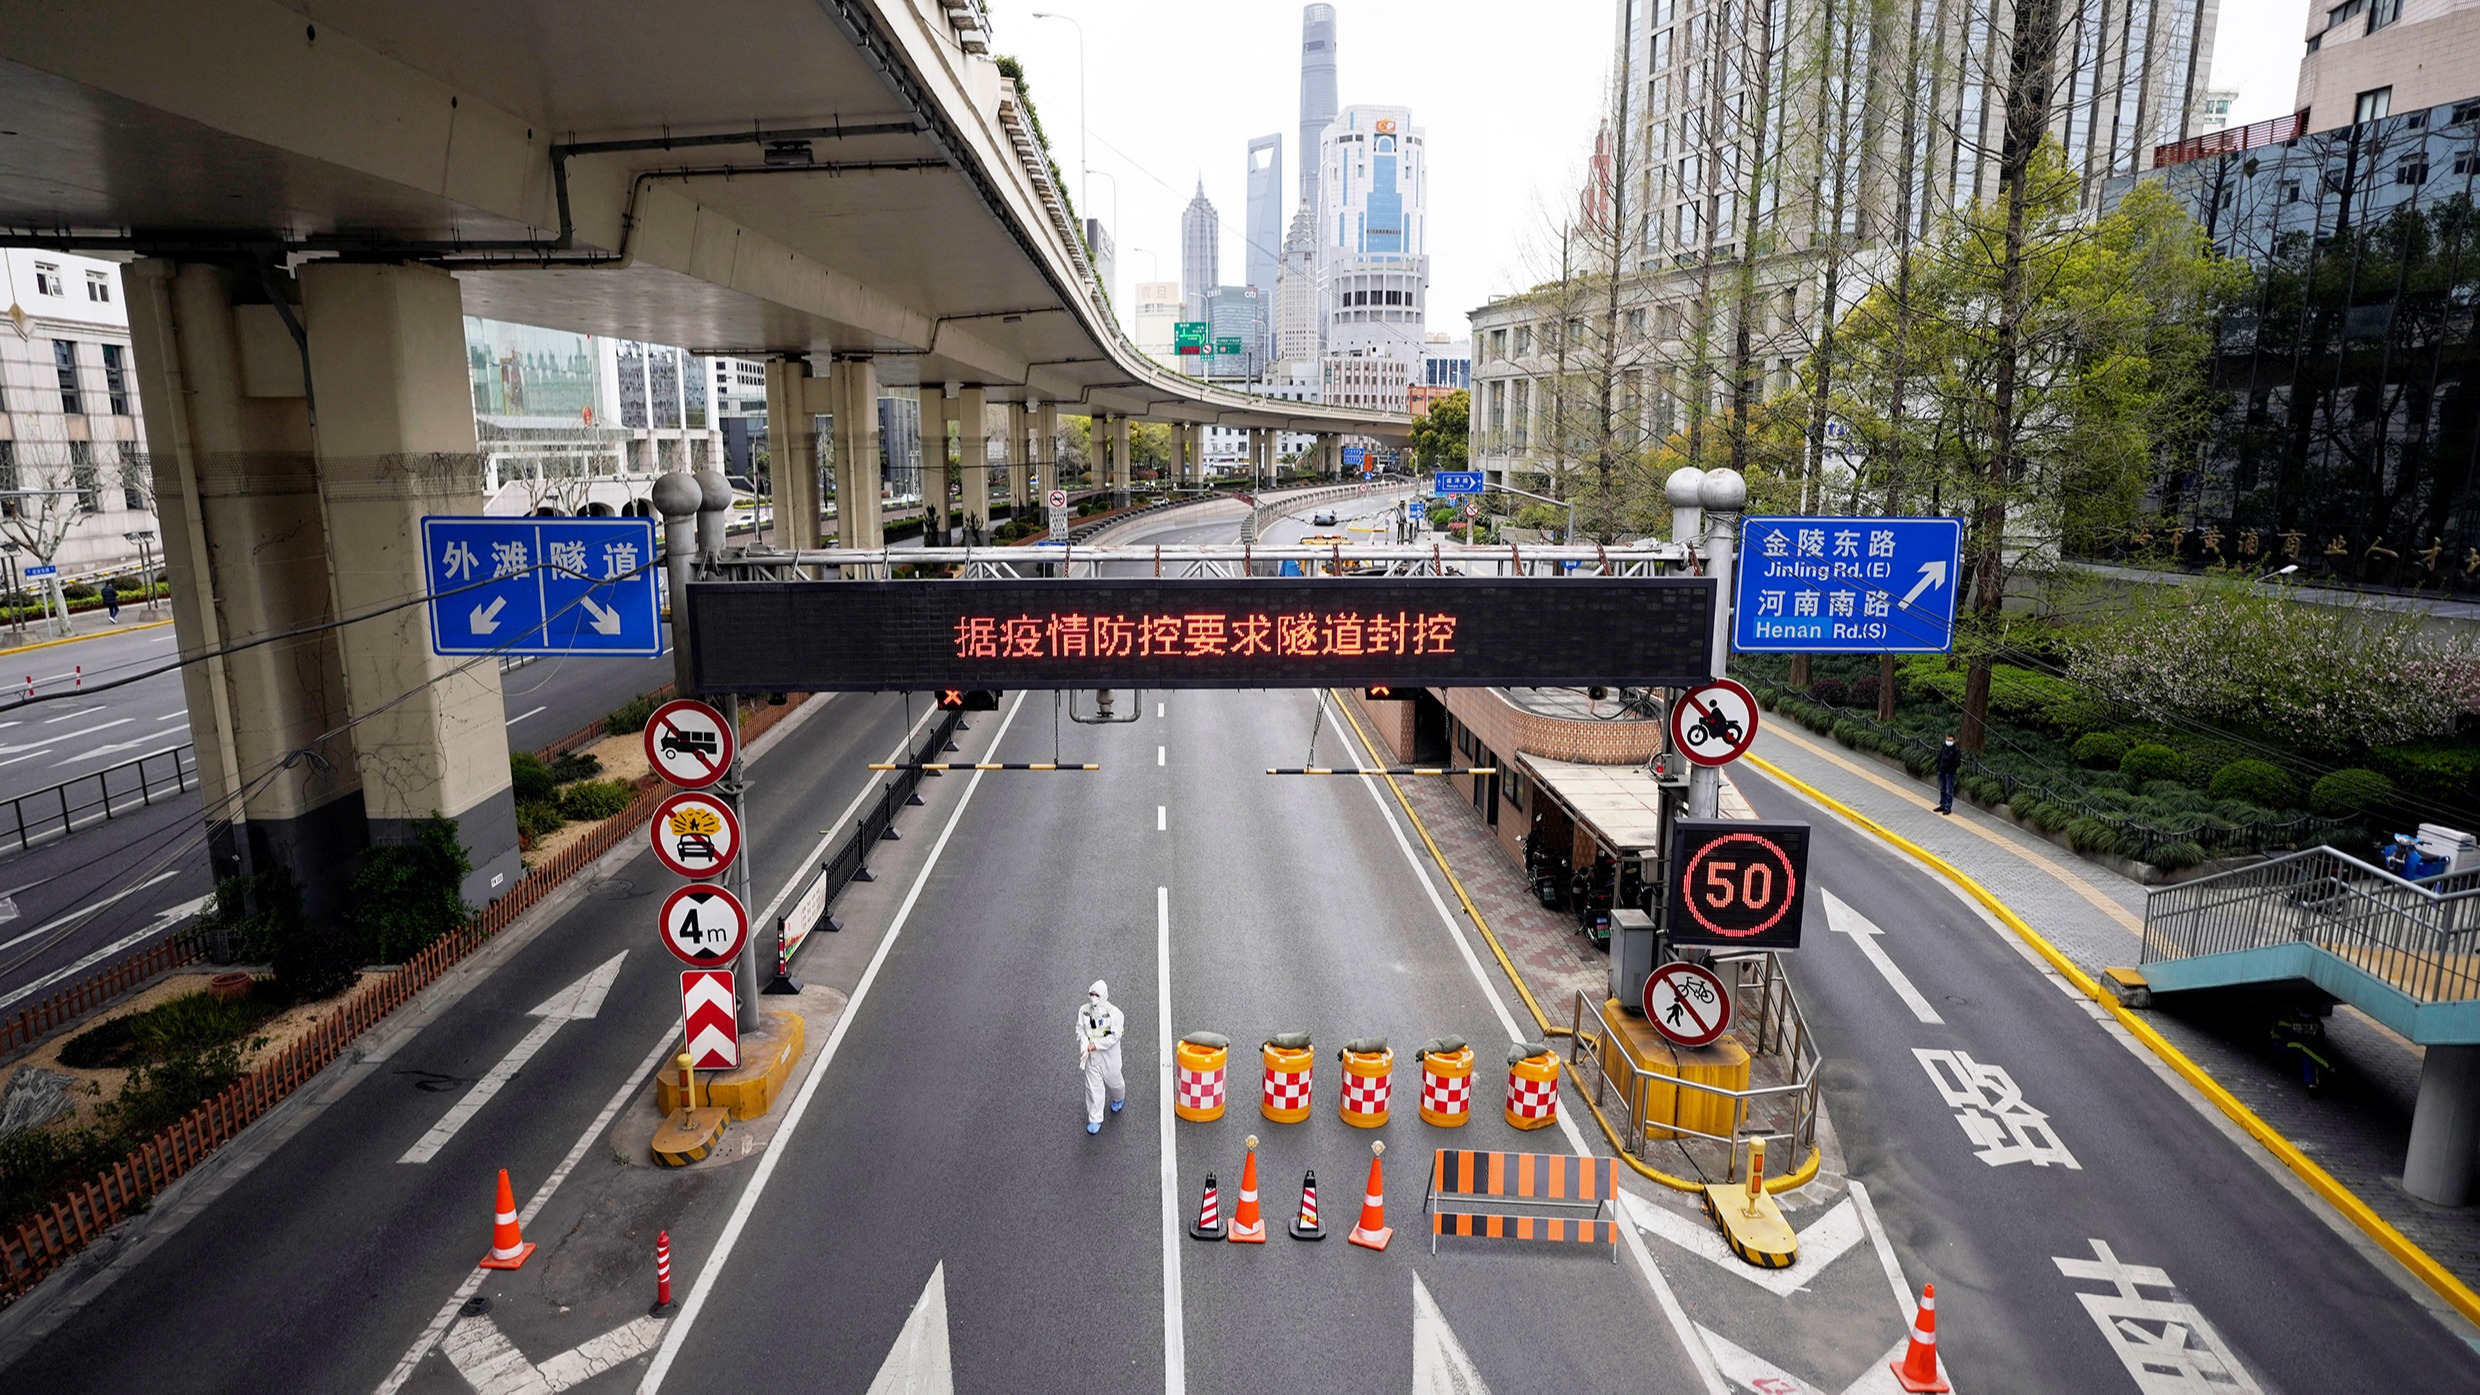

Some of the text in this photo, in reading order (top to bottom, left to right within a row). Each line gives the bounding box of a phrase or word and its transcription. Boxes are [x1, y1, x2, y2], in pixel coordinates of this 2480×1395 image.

[442, 540, 641, 582] 外滩隧道
[1763, 529, 1896, 558] 金陵东路
[1764, 561, 1829, 581] Jinling
[1757, 589, 1890, 617] 河南南路
[954, 612, 1457, 658] 据疫情防控要求隧道封控
[1756, 621, 1822, 638] Henan
[1706, 862, 1772, 909] 50
[1911, 1048, 2082, 1170] 路
